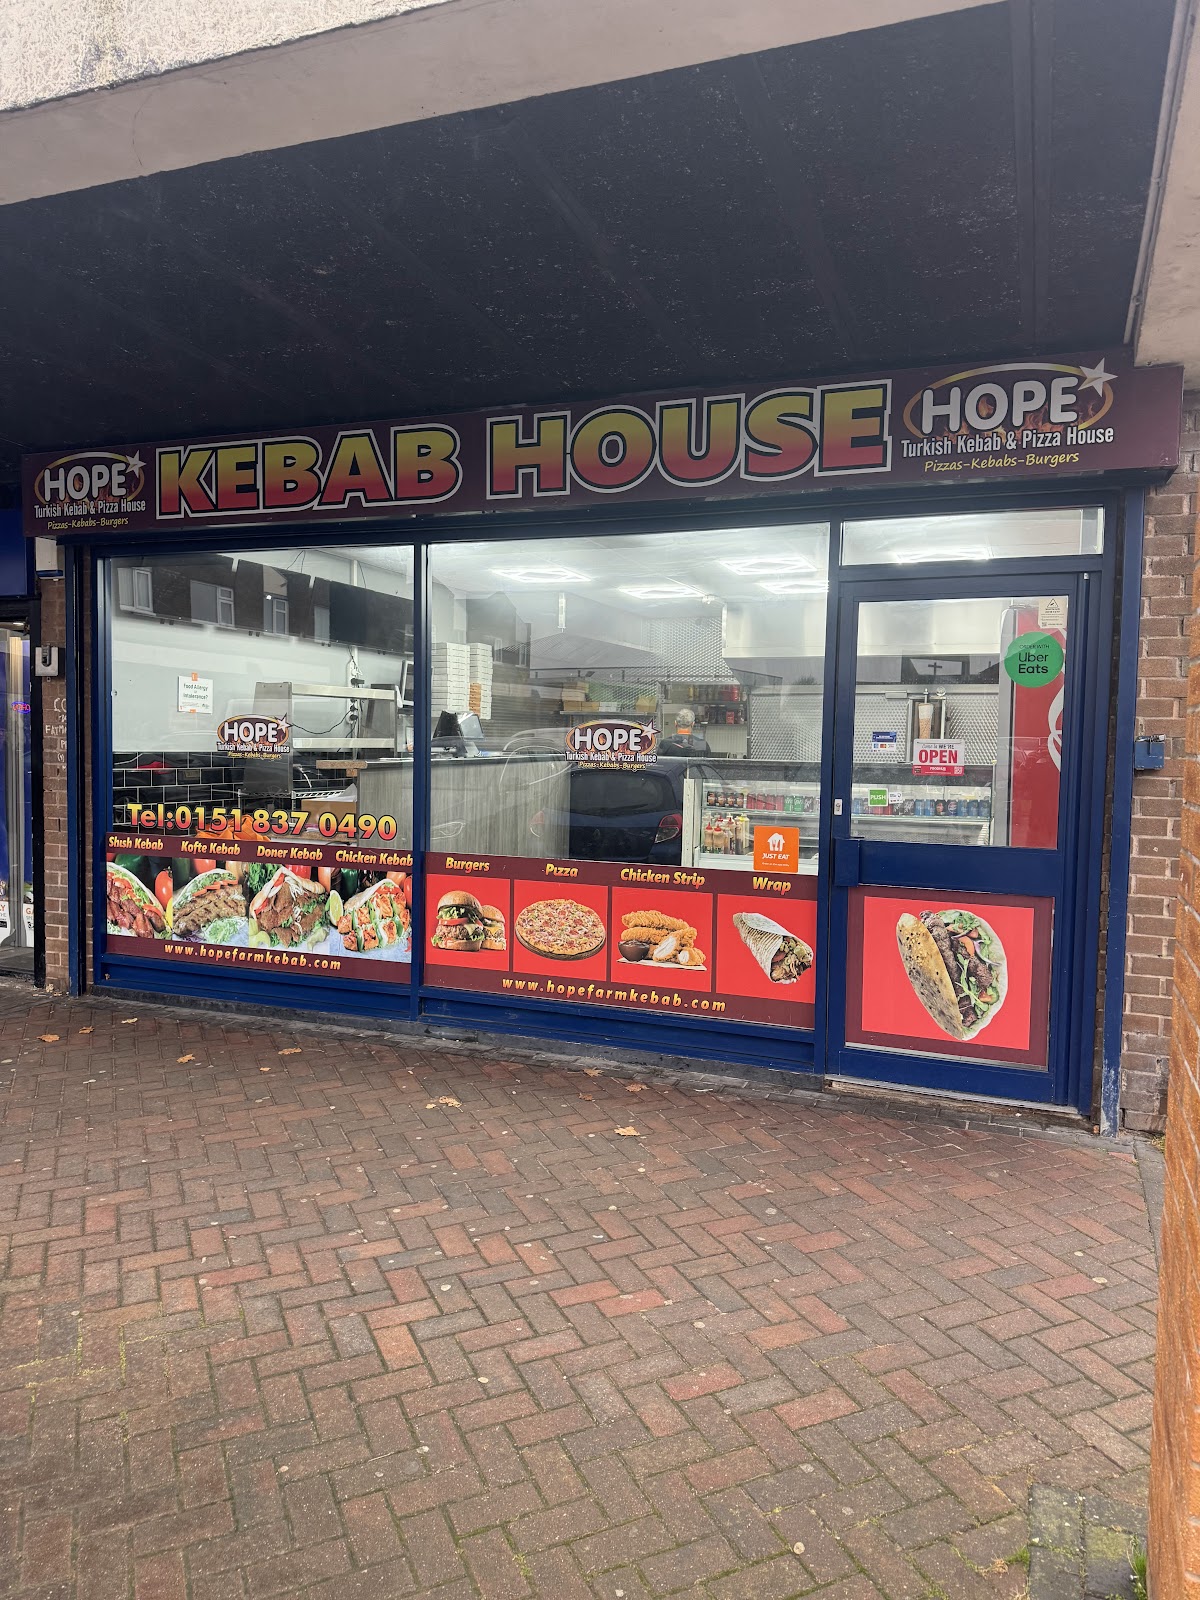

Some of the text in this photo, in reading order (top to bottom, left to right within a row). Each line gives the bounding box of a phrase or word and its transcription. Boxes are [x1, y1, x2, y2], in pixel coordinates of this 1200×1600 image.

[922, 377, 1079, 434] HOPE
[156, 379, 892, 519] KEBAB HOUSE
[901, 427, 1114, 458] Turkish Kebab & Pizza House
[924, 452, 1079, 472] Pizzas-Kebabs-Burgers
[44, 463, 127, 502] HOPE
[34, 500, 146, 519] Turkish Kebab & Pizza House
[47, 517, 129, 530] Pizzas-Kebabs-Burgers
[1018, 652, 1049, 662] Uber
[1018, 664, 1049, 674] Eats
[224, 722, 278, 742] HOPE
[574, 728, 642, 751] HOPE
[217, 742, 235, 751] Turkish
[237, 742, 252, 752] Kebab
[259, 744, 272, 752] Pizza
[274, 744, 289, 753] House
[566, 751, 588, 760] Turkish
[590, 751, 609, 761] Kebab
[618, 752, 634, 761] Pizza
[637, 752, 657, 762] House
[919, 749, 958, 763] OPEN
[127, 803, 398, 841] Tel:0151 837 0490
[108, 835, 163, 850] Shish Kebab
[180, 840, 240, 855] Kofte Kebab
[256, 845, 323, 860] Doner Kebab
[335, 850, 413, 866] Chicken Kebab
[445, 857, 490, 873] Burgers
[545, 863, 579, 877] Pizza
[620, 868, 705, 889] Chicken Strip
[752, 876, 792, 895] Wrap
[164, 943, 342, 971] www.hopefarmkebab.com
[501, 977, 727, 1012] www.hopefarmkebab.com
